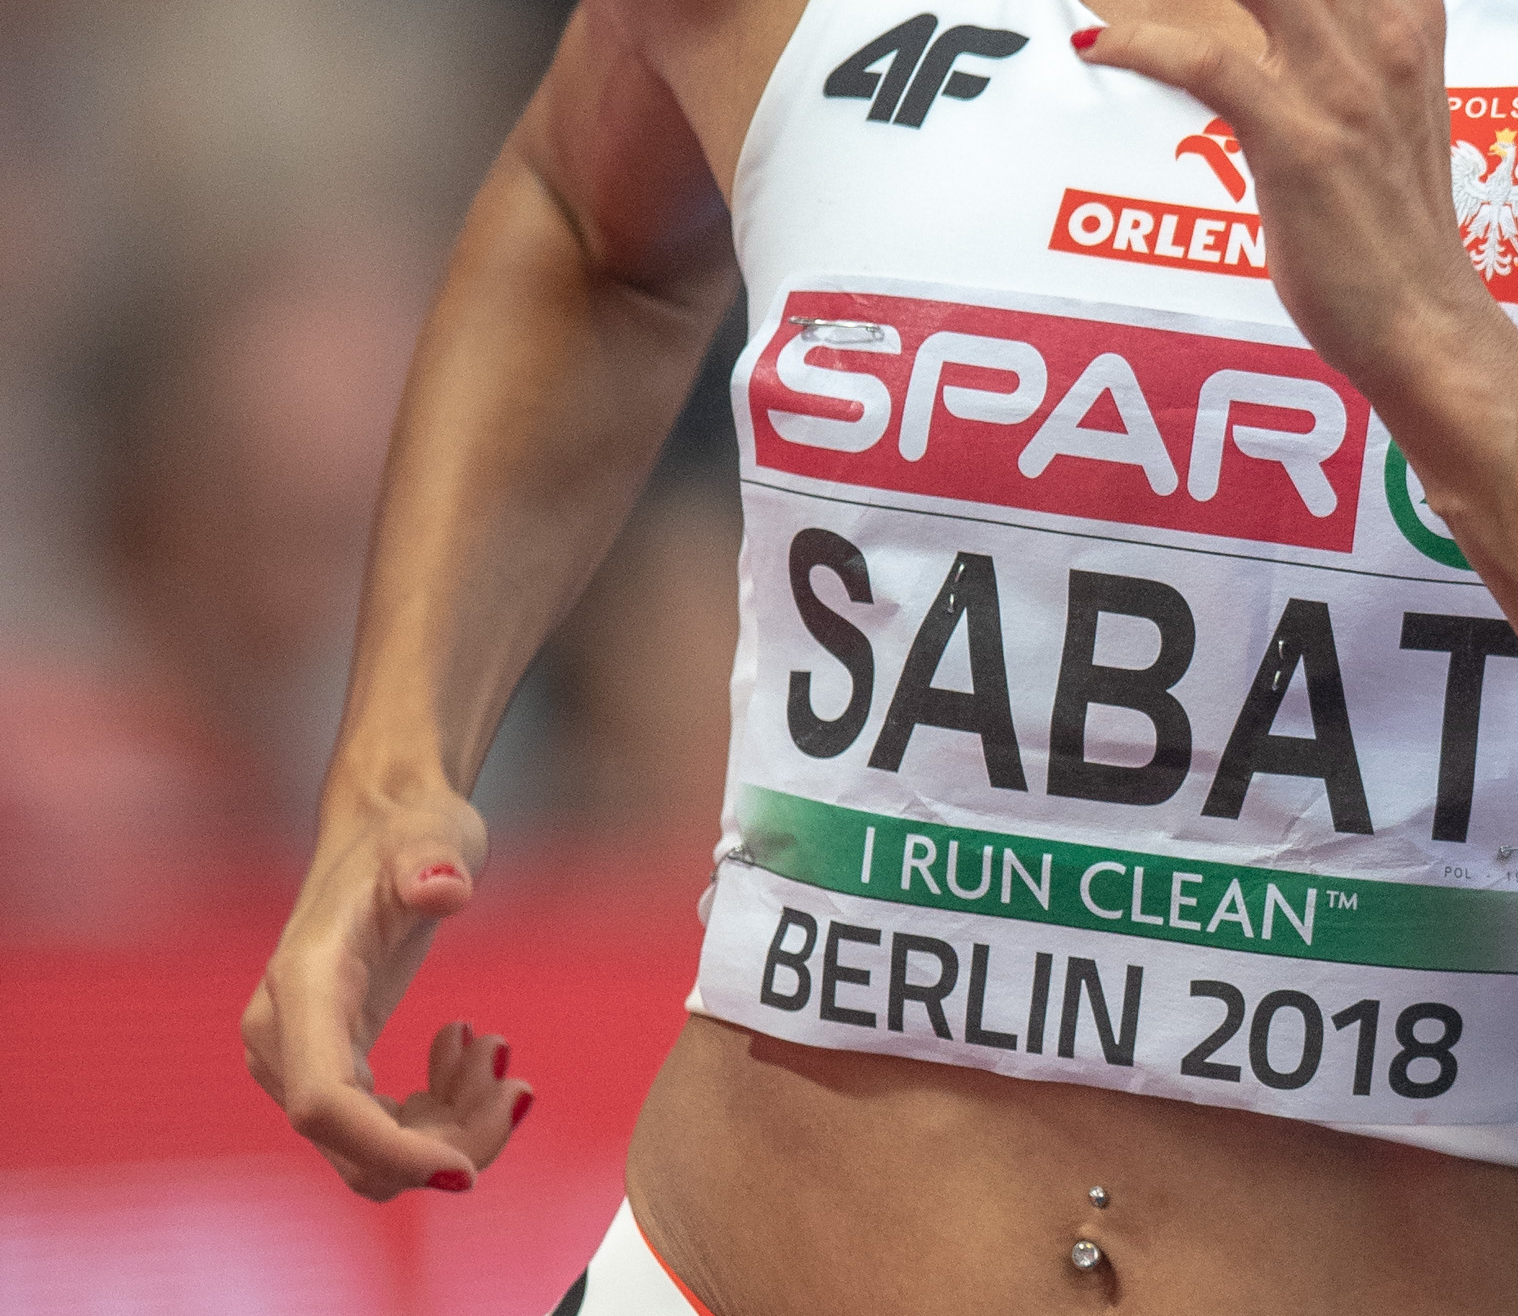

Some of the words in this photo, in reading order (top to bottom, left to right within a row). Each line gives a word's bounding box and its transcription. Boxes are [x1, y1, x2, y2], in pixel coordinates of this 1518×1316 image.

[823, 13, 1030, 129] 4F
[1067, 201, 1267, 268] ORLEN
[768, 322, 1348, 518] SPAR
[860, 827, 876, 884] I
[900, 834, 1053, 911] RUN
[1444, 866, 1472, 880] POL
[760, 906, 1143, 1068] BERLIN
[1180, 980, 1463, 1100] 2018
